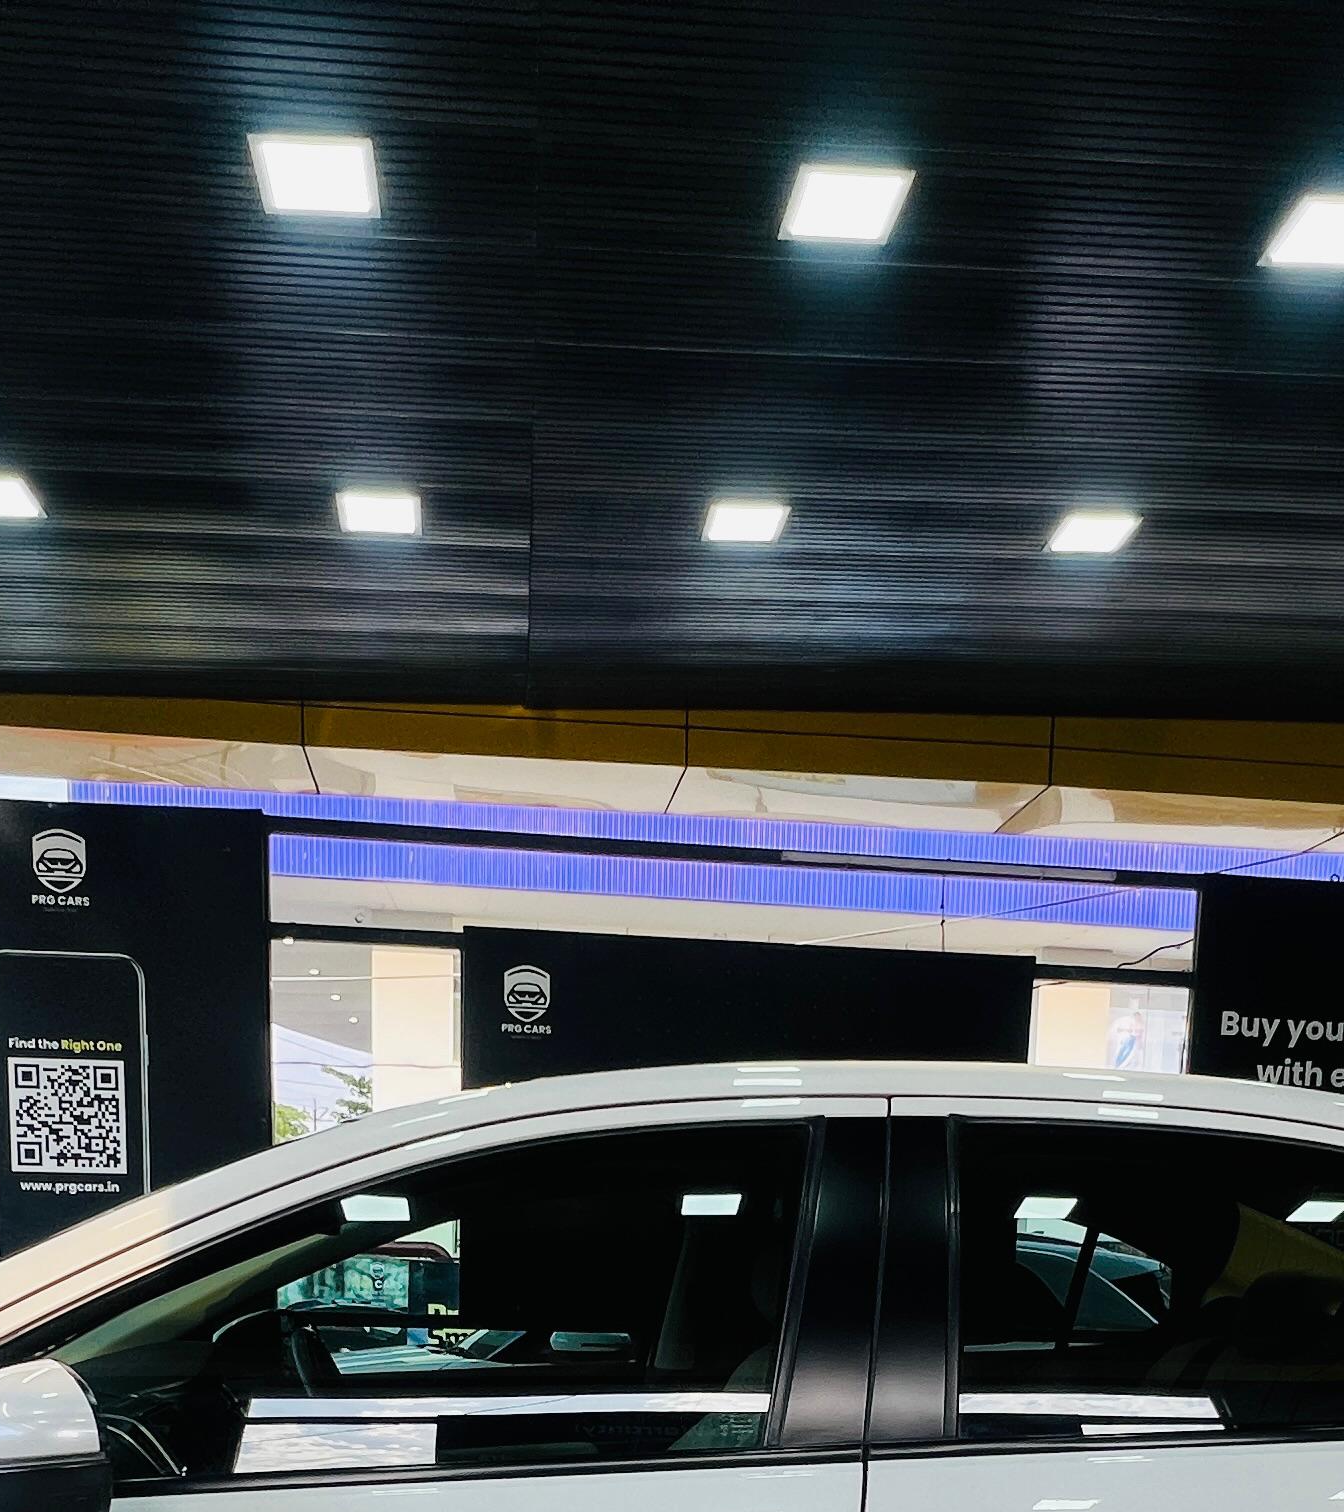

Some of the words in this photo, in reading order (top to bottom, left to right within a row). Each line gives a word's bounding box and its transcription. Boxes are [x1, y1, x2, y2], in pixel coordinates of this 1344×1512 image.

[57, 895, 90, 907] CARS
[523, 1024, 552, 1035] CARS
[1220, 1011, 1281, 1047] Buy
[7, 1036, 36, 1049] Find
[37, 1037, 59, 1050] the
[60, 1039, 95, 1053] Right
[96, 1040, 123, 1052] One
[1256, 1058, 1324, 1088] with
[20, 1180, 120, 1195] www.prgcars.in
